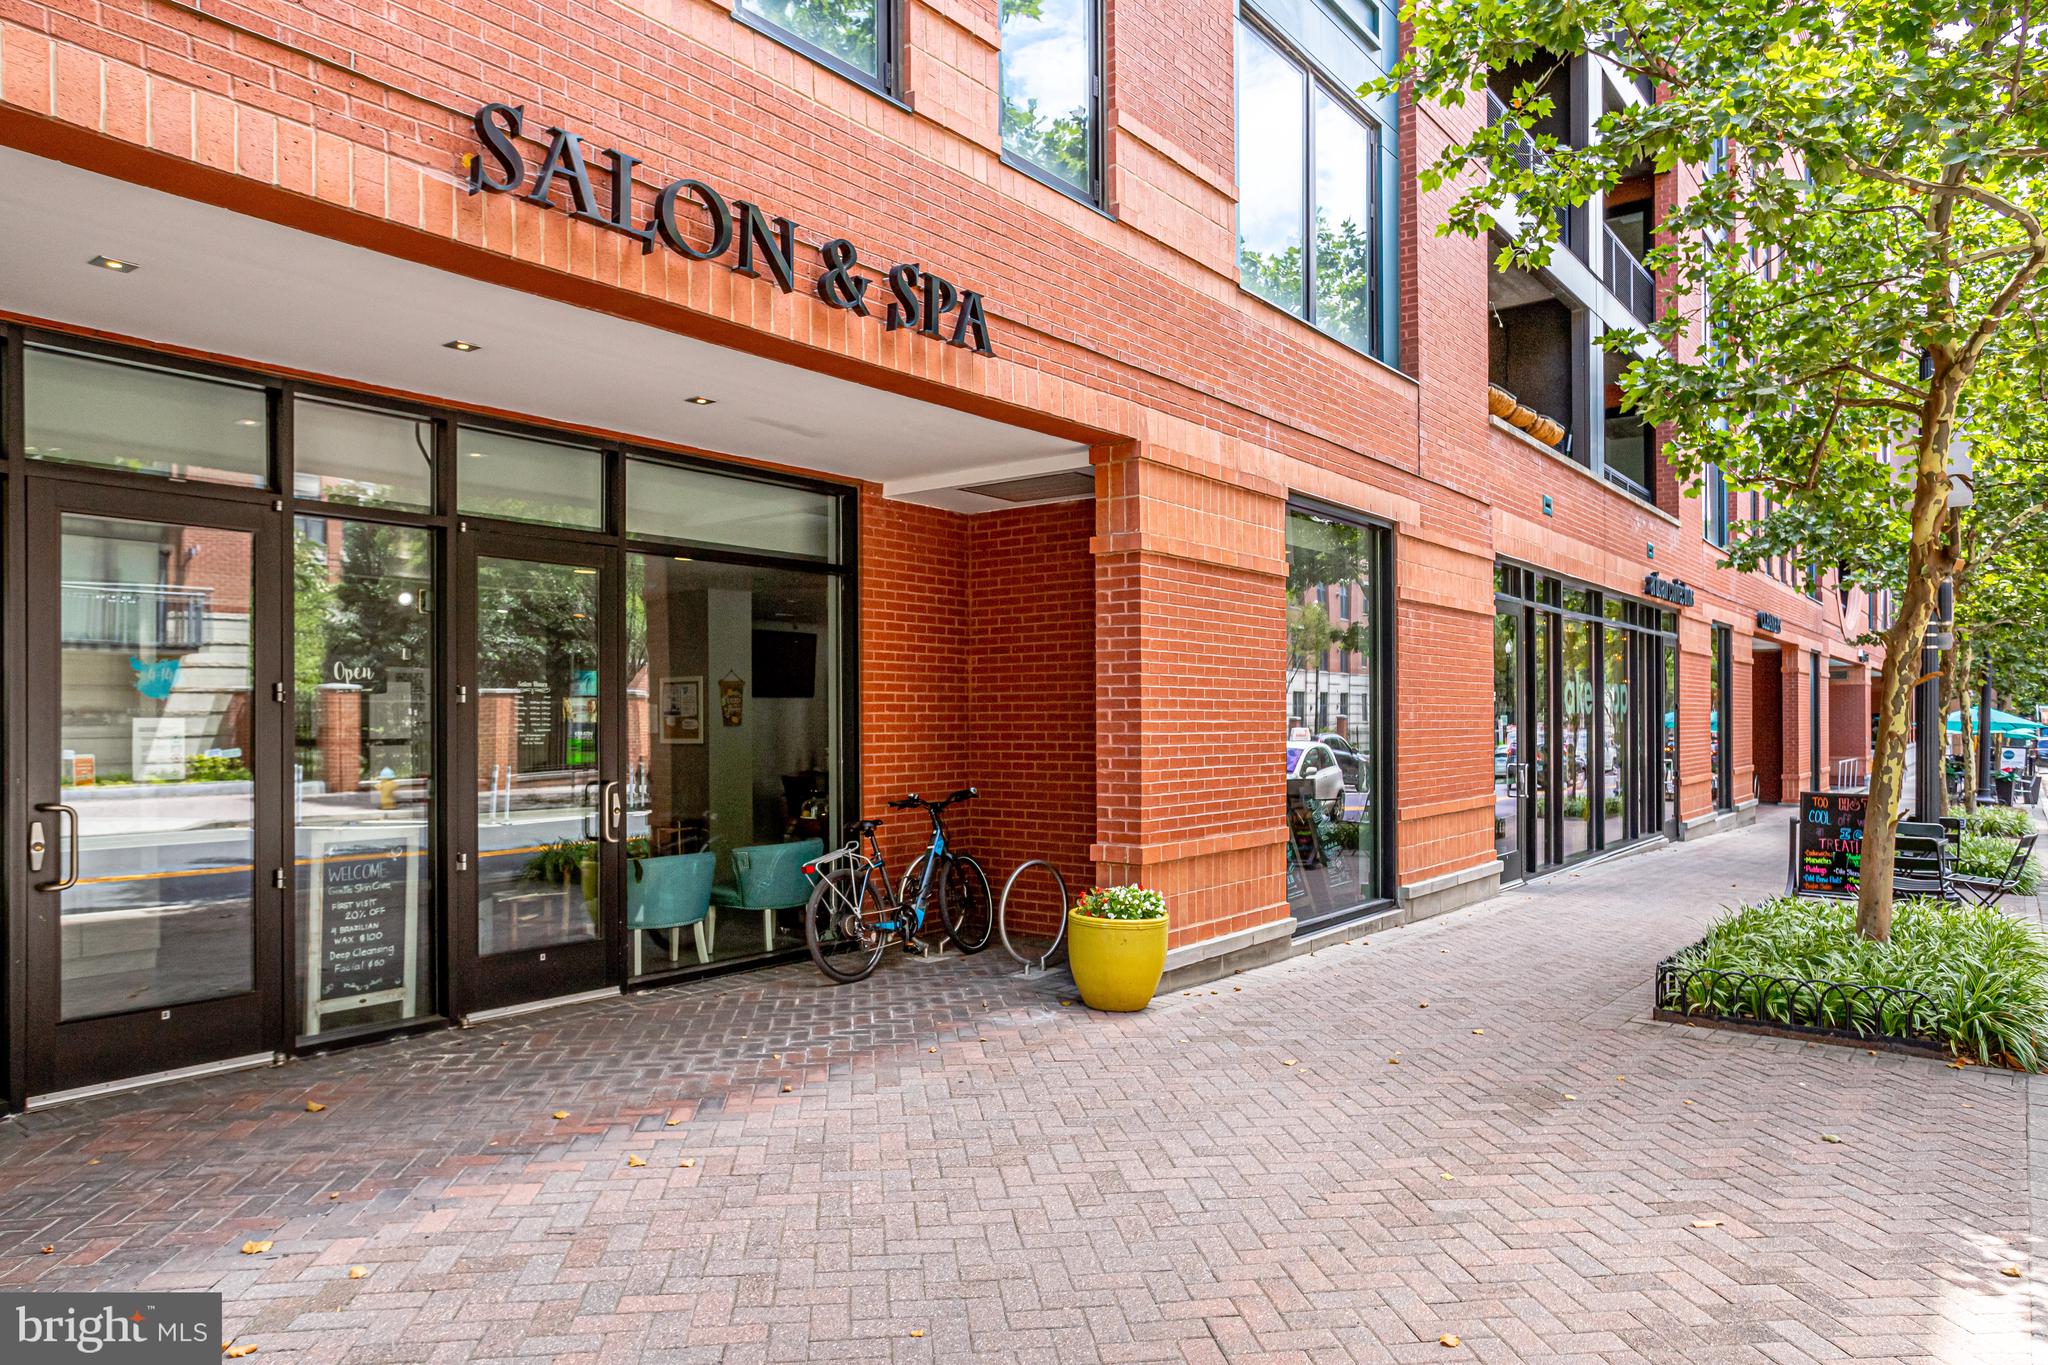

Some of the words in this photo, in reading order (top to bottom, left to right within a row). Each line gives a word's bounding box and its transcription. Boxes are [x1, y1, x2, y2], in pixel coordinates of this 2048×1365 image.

[468, 102, 799, 294] SALON
[817, 238, 873, 317] &
[886, 262, 997, 358] SPA
[334, 661, 375, 684] Open
[1564, 671, 1593, 715] ake
[1812, 796, 1828, 808] TOO
[1809, 809, 1832, 825] COOL
[328, 861, 387, 882] WELCOME
[331, 901, 354, 910] FIRST
[355, 898, 378, 908] VISIT
[345, 909, 366, 920] 20%
[369, 906, 386, 916] OFF
[340, 922, 379, 934] BRAZILIAN
[334, 936, 354, 945] WAX
[359, 931, 383, 942] $100
[329, 951, 351, 961] Deep
